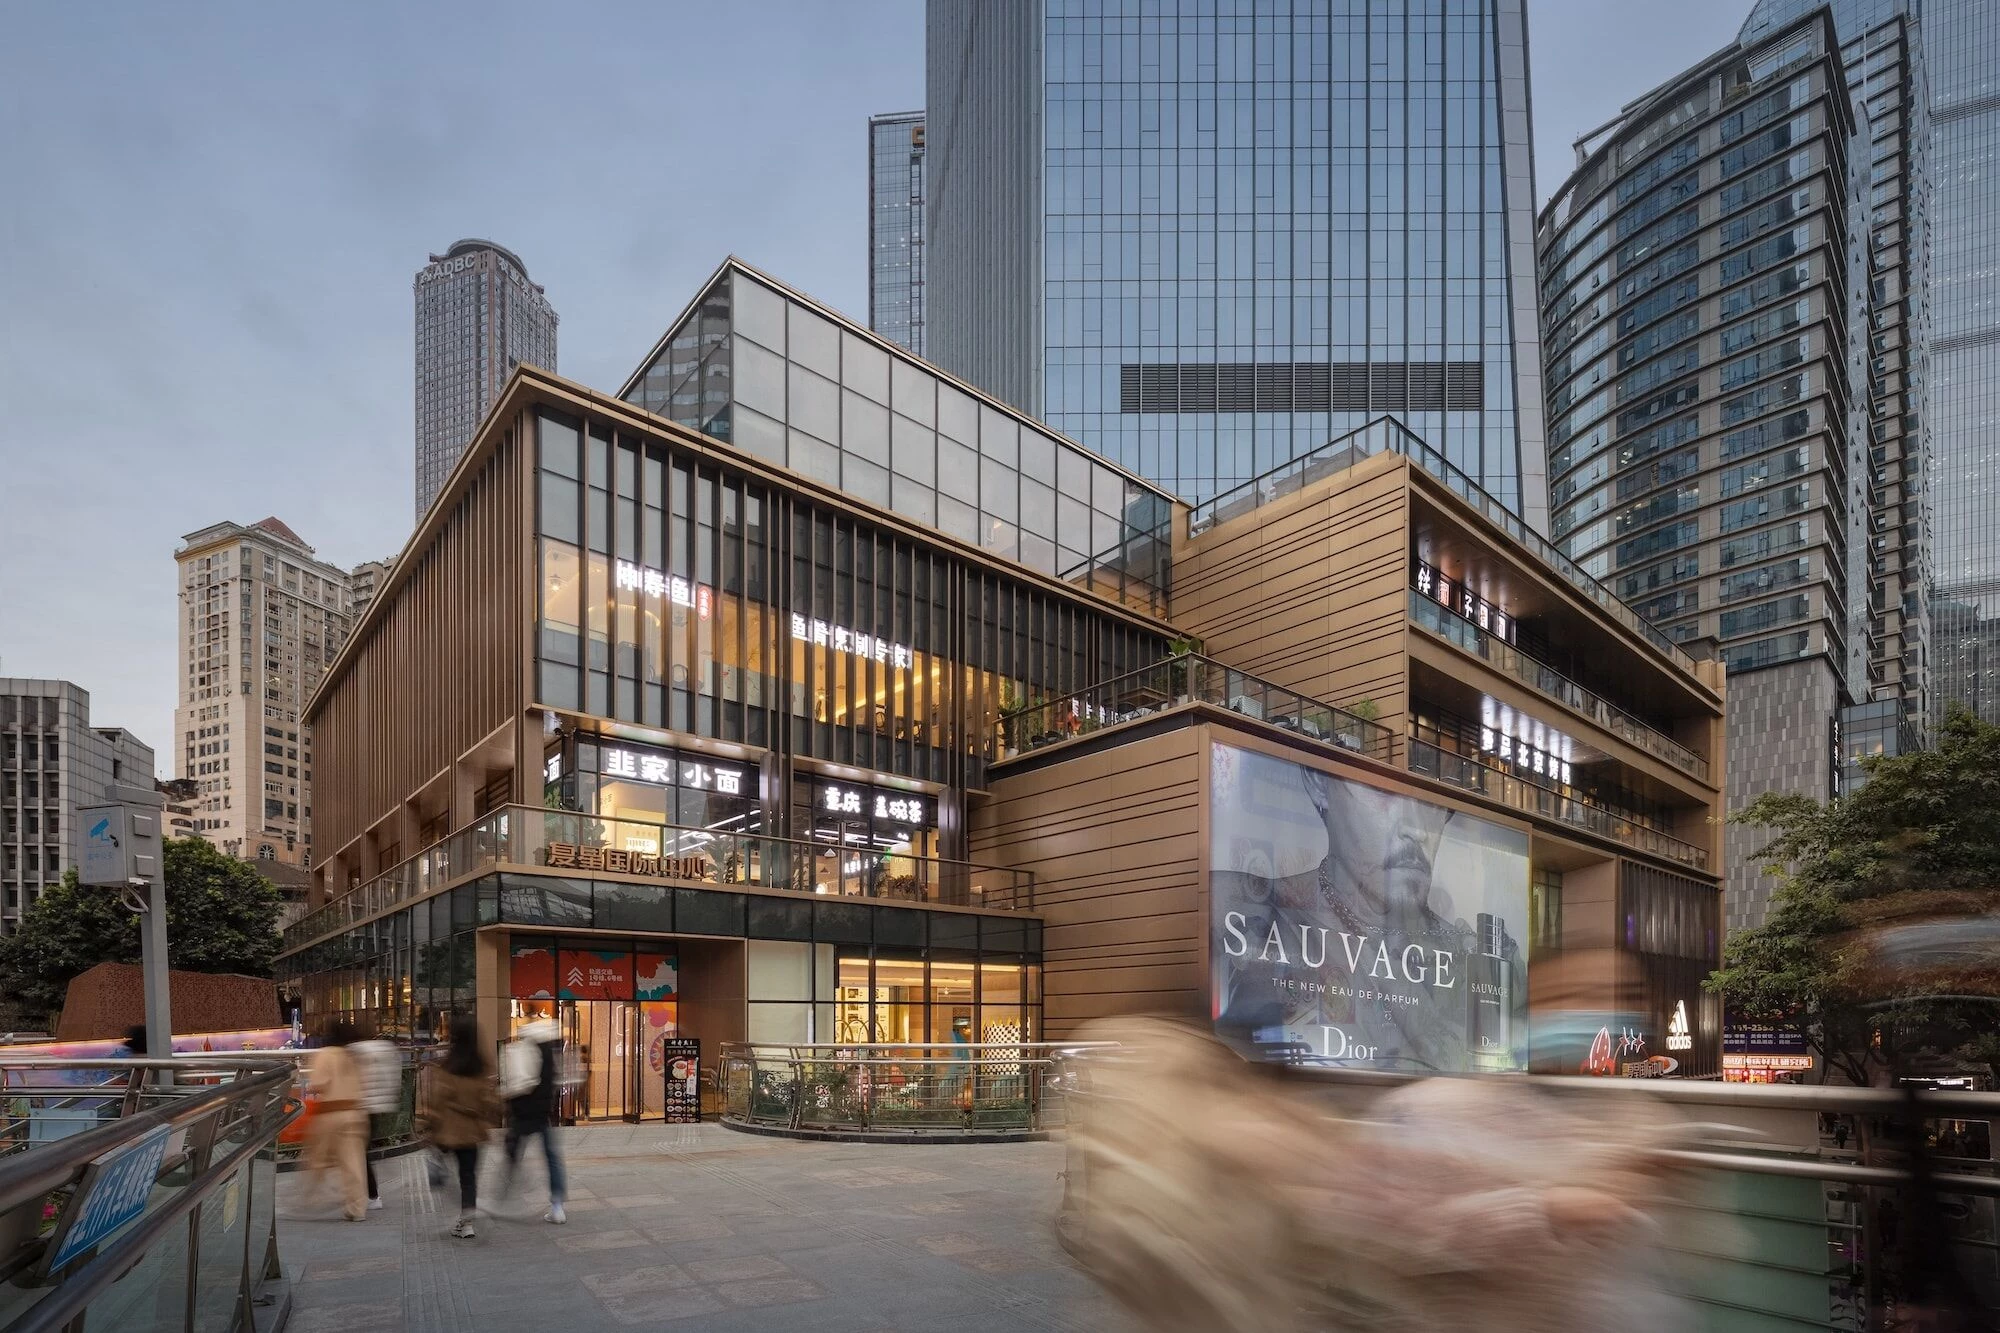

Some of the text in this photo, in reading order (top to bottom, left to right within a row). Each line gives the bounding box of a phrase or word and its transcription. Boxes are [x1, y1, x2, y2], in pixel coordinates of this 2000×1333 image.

[1222, 910, 1456, 989] SAUVAGE
[1272, 977, 1419, 1006] THE NEW EAU DE PARFUM
[1320, 1025, 1378, 1062] Dior
